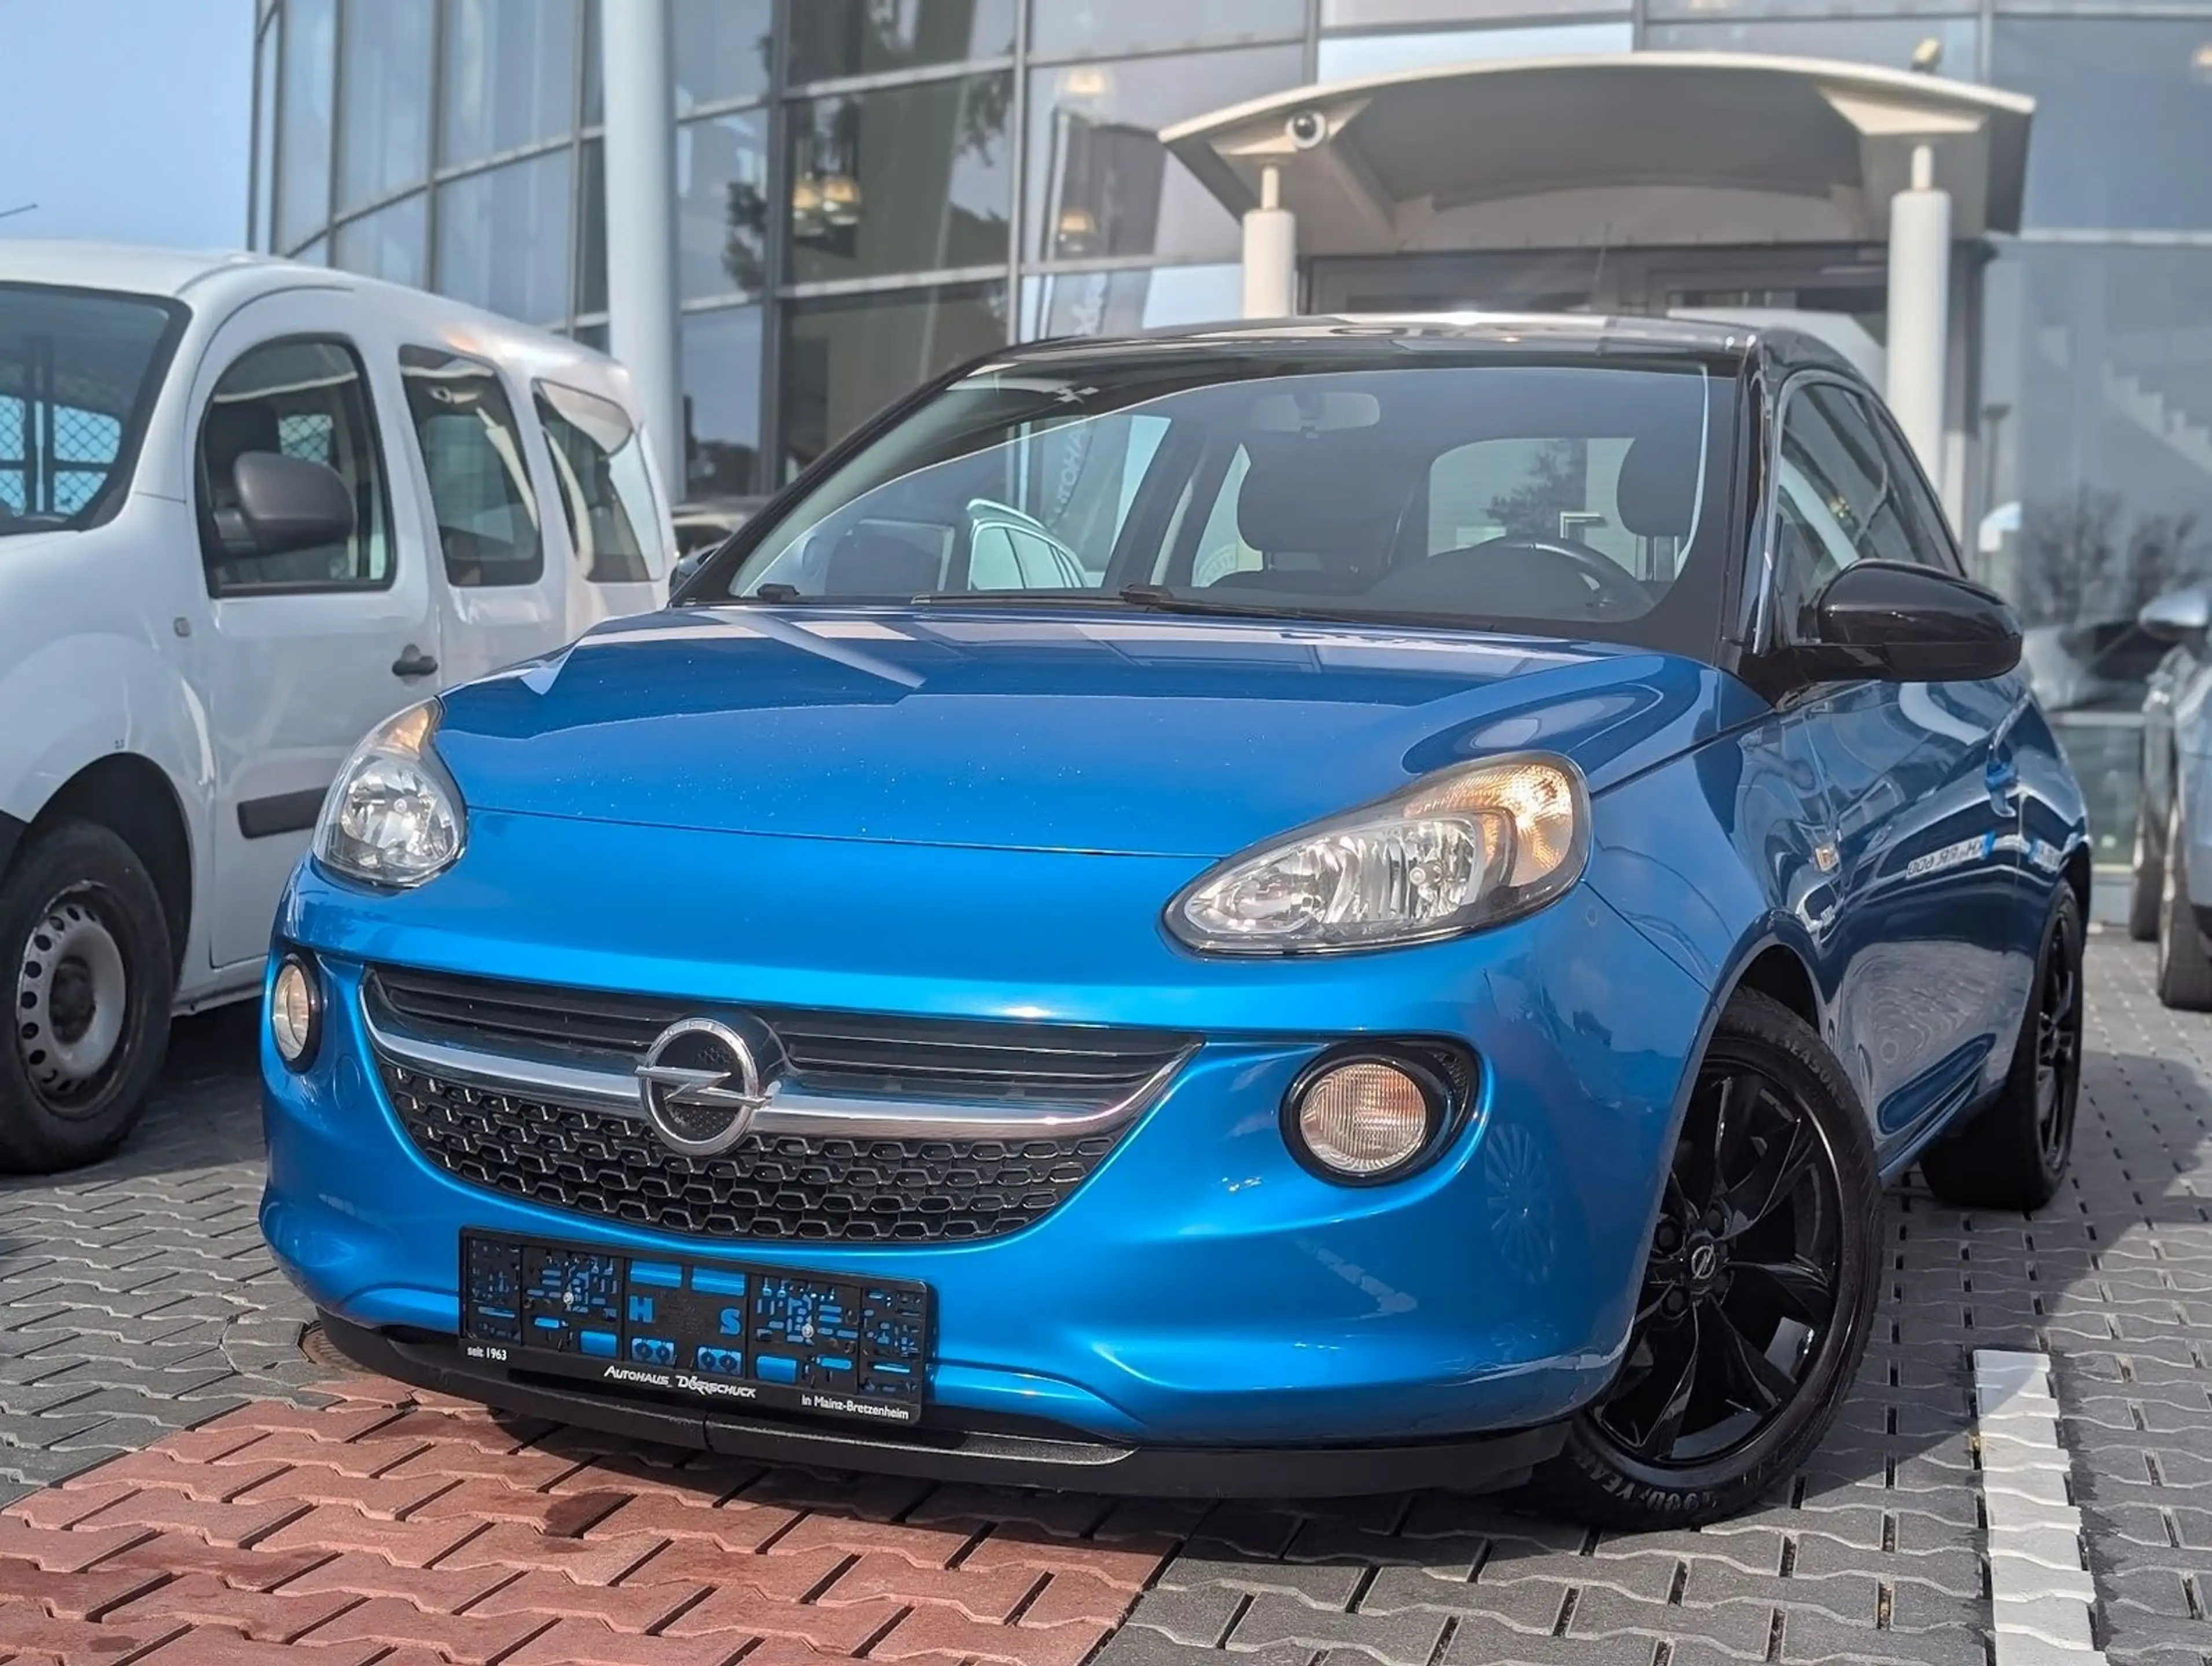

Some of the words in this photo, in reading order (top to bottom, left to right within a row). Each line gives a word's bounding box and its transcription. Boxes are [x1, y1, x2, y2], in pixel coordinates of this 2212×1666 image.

[629, 1295, 654, 1323] H
[719, 1309, 741, 1335] S
[486, 1347, 507, 1361] 1963
[814, 1395, 910, 1421] Mainz-Bretzenheim
